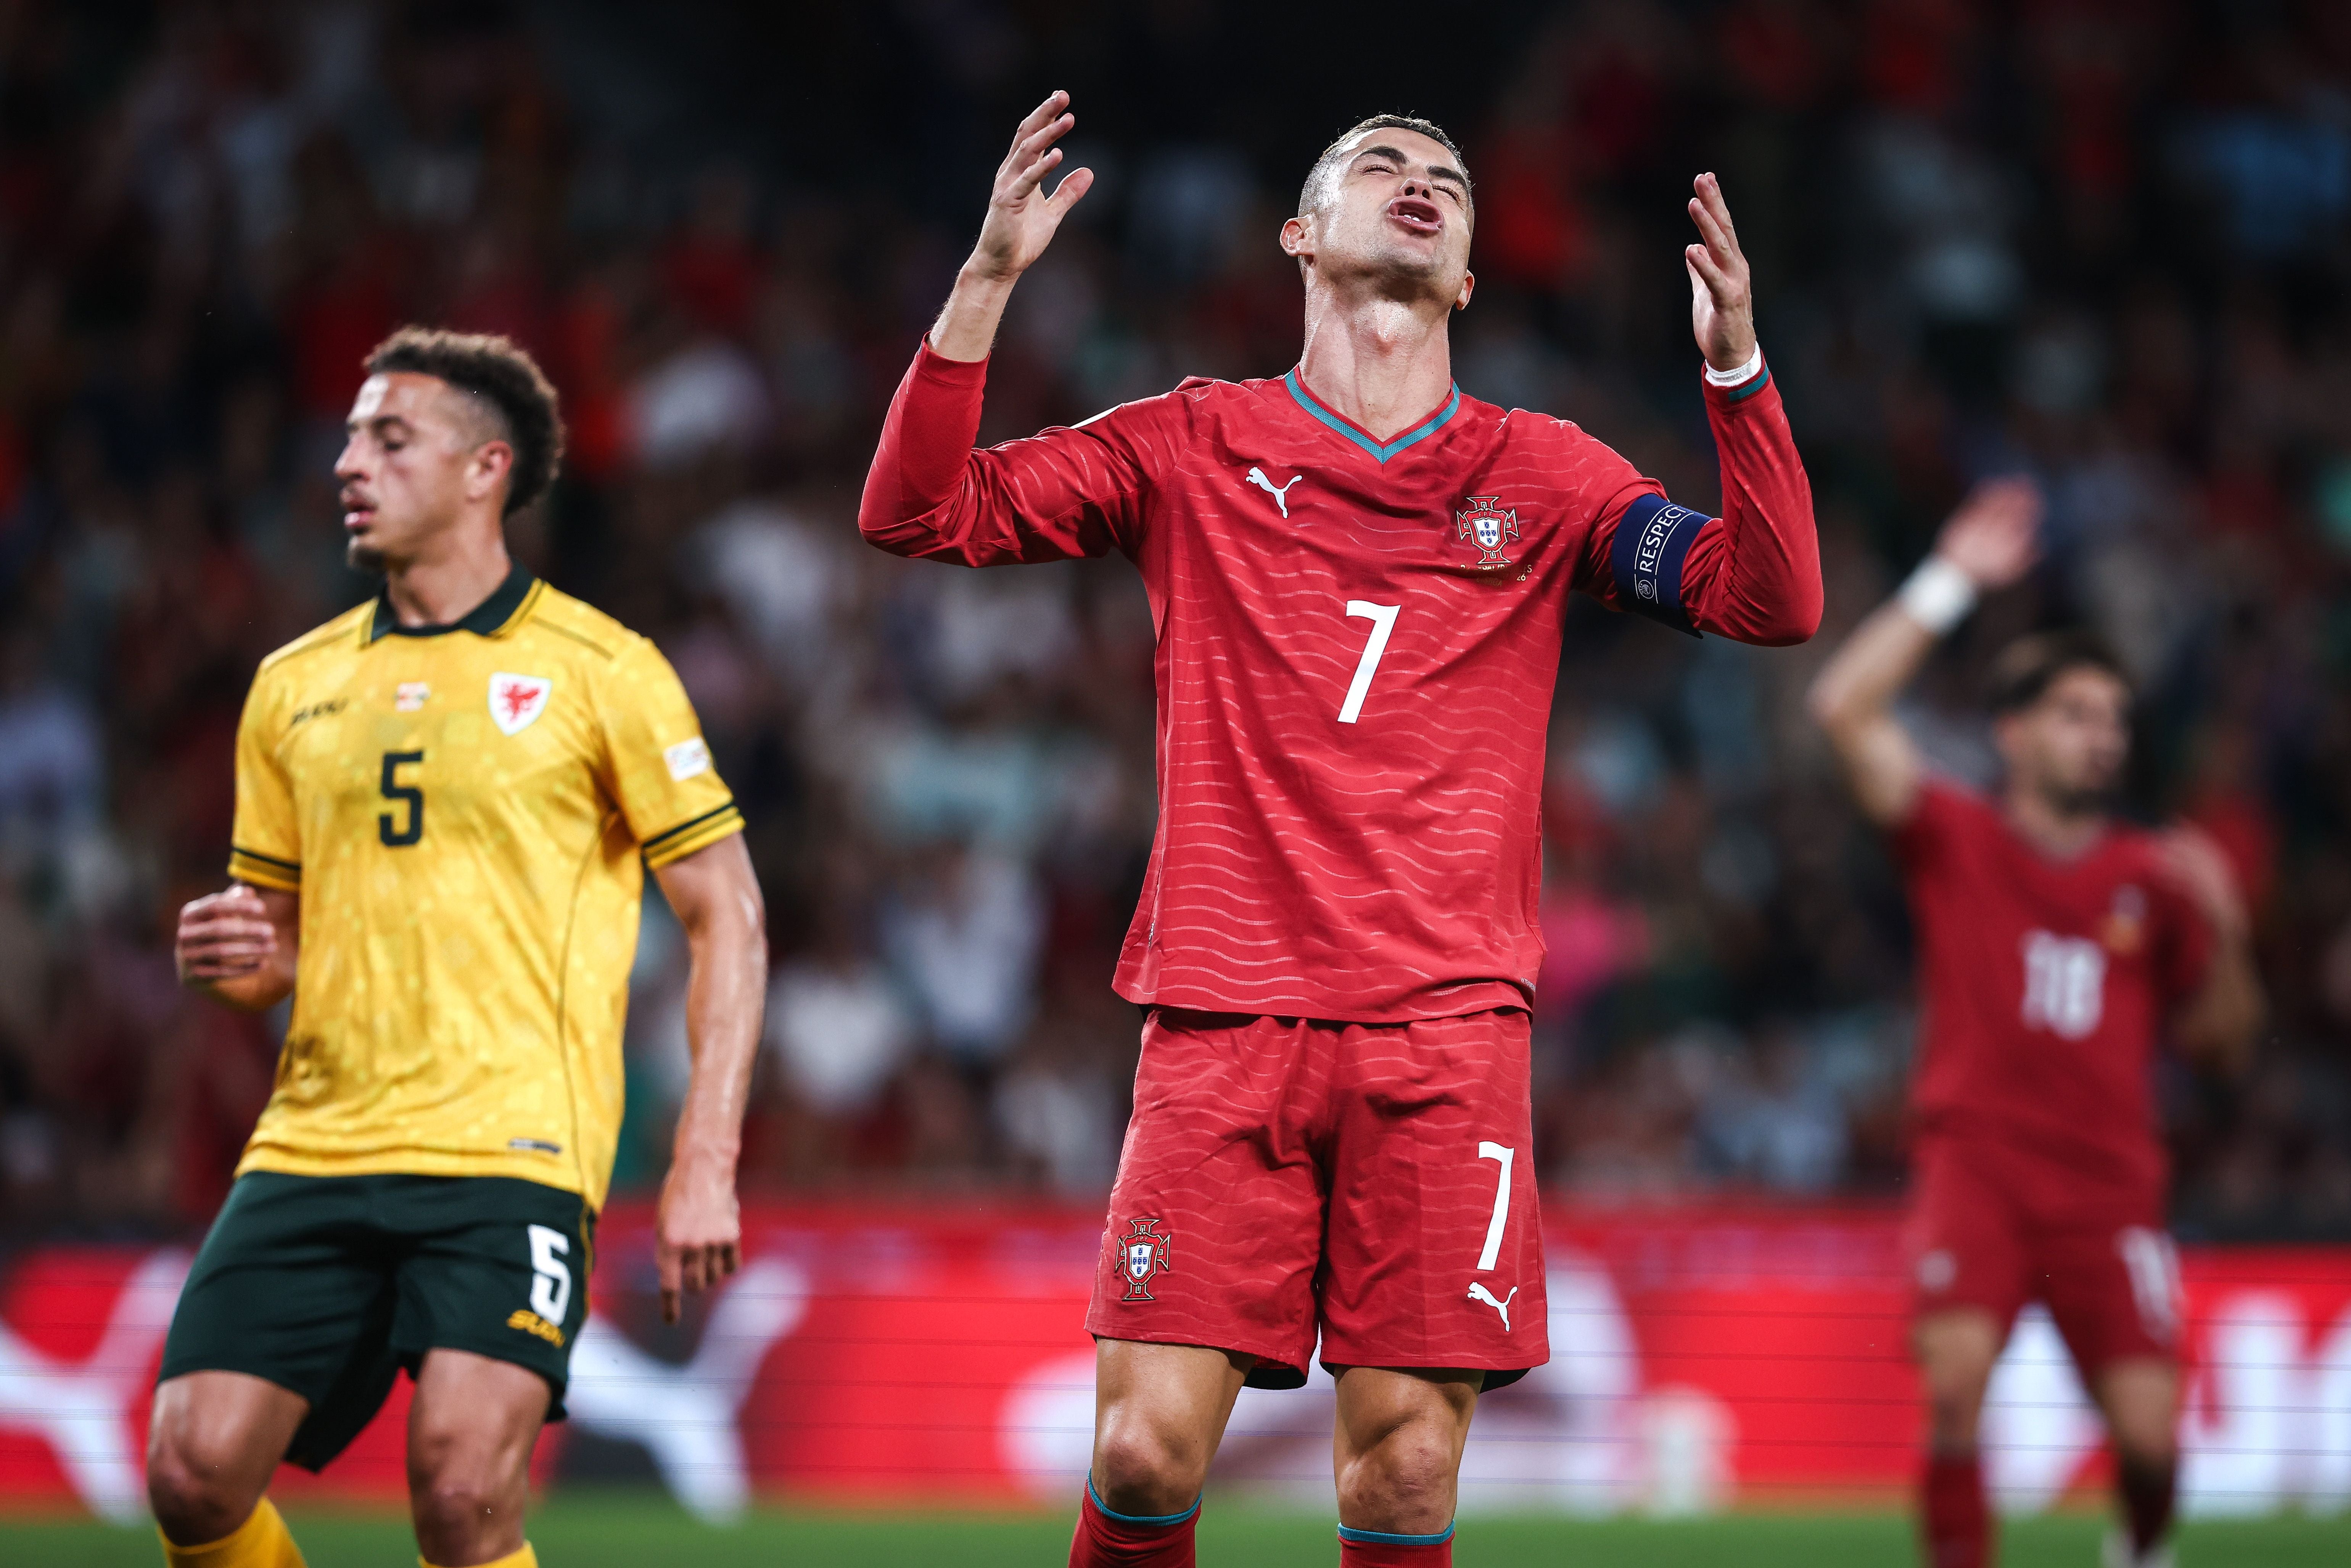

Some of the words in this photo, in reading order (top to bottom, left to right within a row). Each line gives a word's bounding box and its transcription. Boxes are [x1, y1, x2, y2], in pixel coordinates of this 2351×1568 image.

[1640, 507, 1686, 573] RESPECT
[1337, 600, 1401, 724] 7
[380, 750, 422, 846] 5
[1477, 1141, 1514, 1271] 7
[527, 1224, 571, 1327] 5
